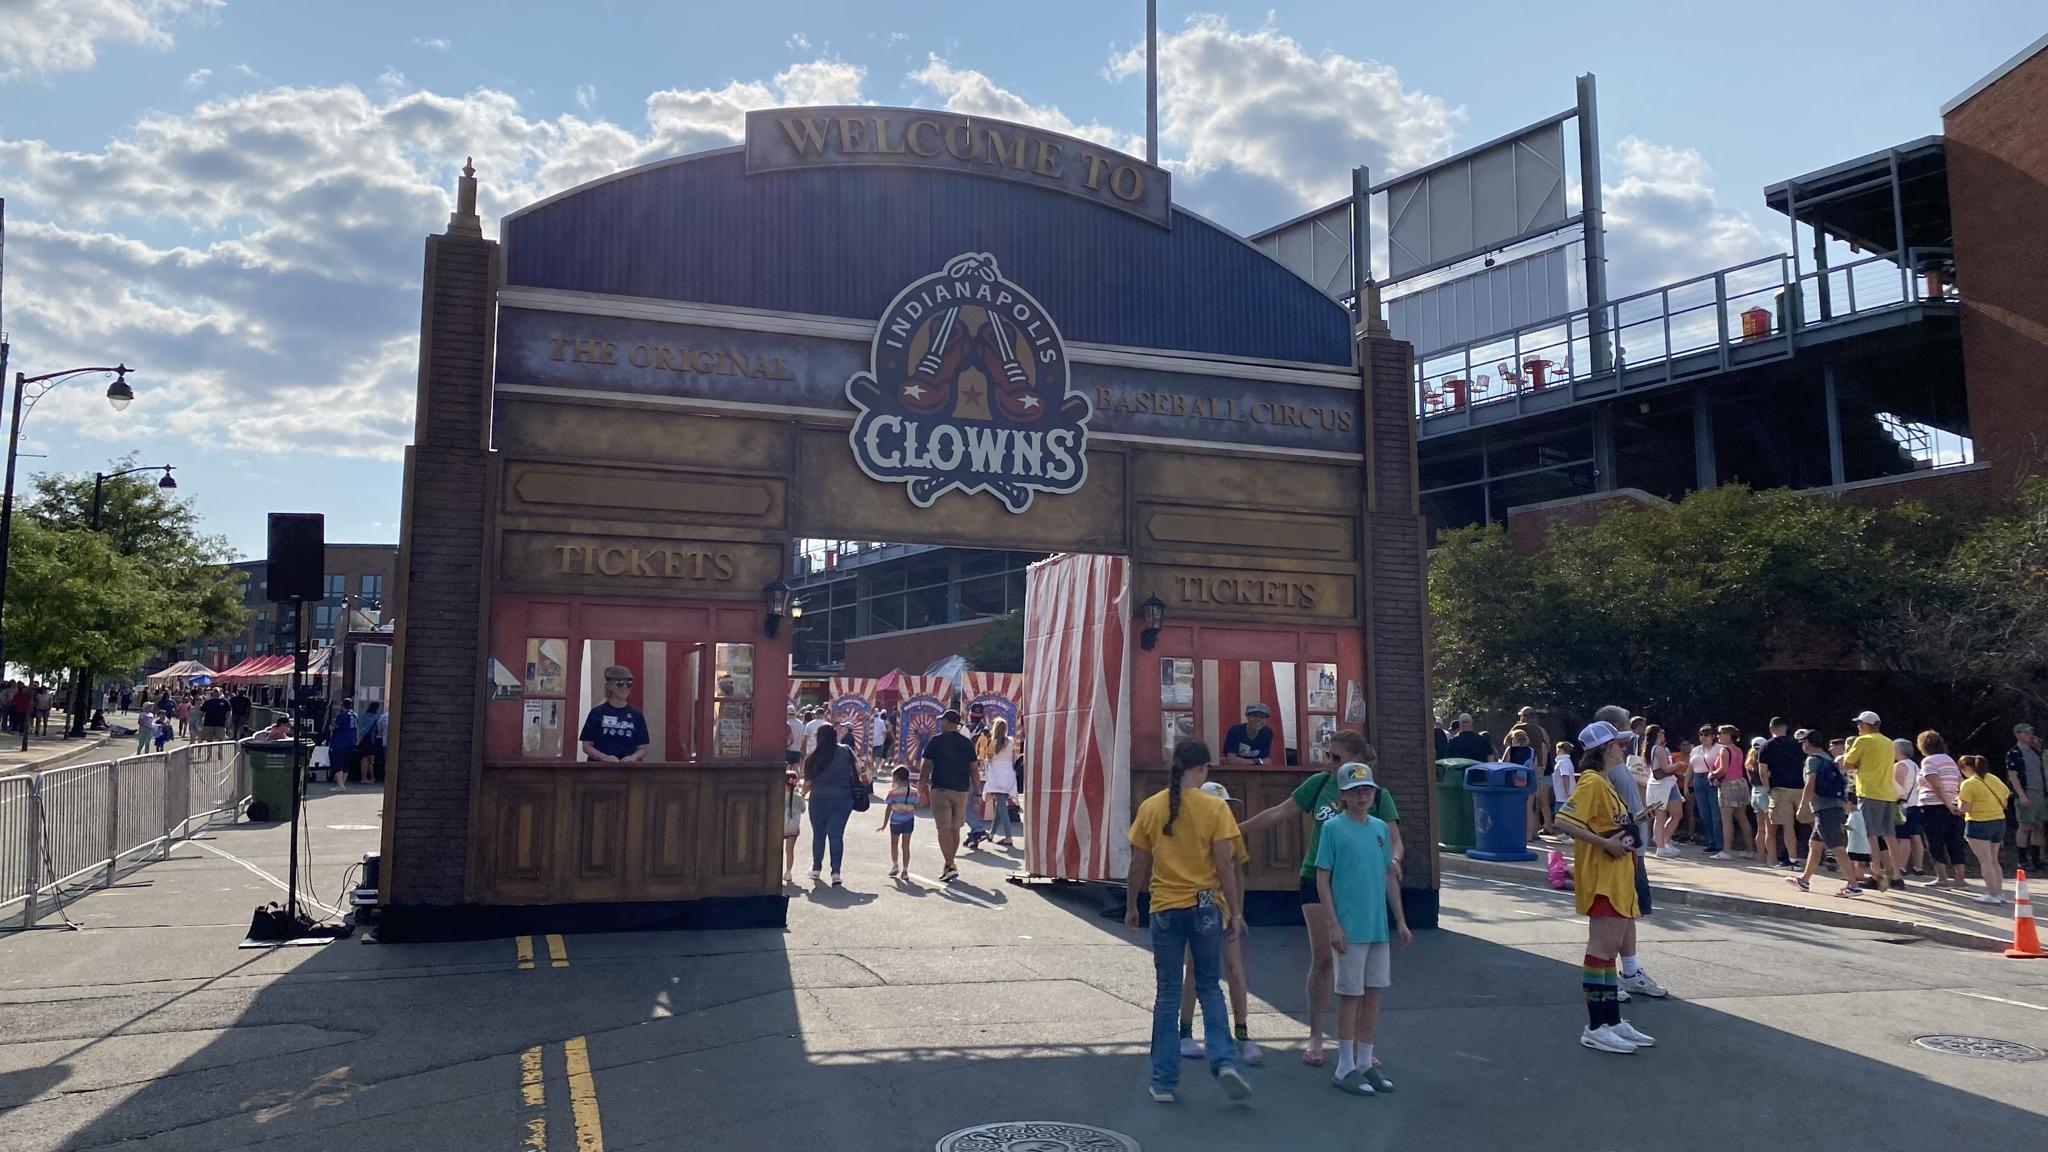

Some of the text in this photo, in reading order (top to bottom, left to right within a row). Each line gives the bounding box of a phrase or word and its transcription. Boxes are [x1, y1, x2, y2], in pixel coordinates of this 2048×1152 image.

[777, 116, 1145, 201] WELCOME TO
[886, 281, 1056, 364] INDIANAPOLIS
[551, 338, 795, 381] THE ORIGINAL
[1095, 387, 1352, 432] BASEBALL CIRCUS
[864, 414, 1077, 481] CLOWNS
[554, 545, 735, 581] TICKETS
[1175, 576, 1316, 608] TICKETS
